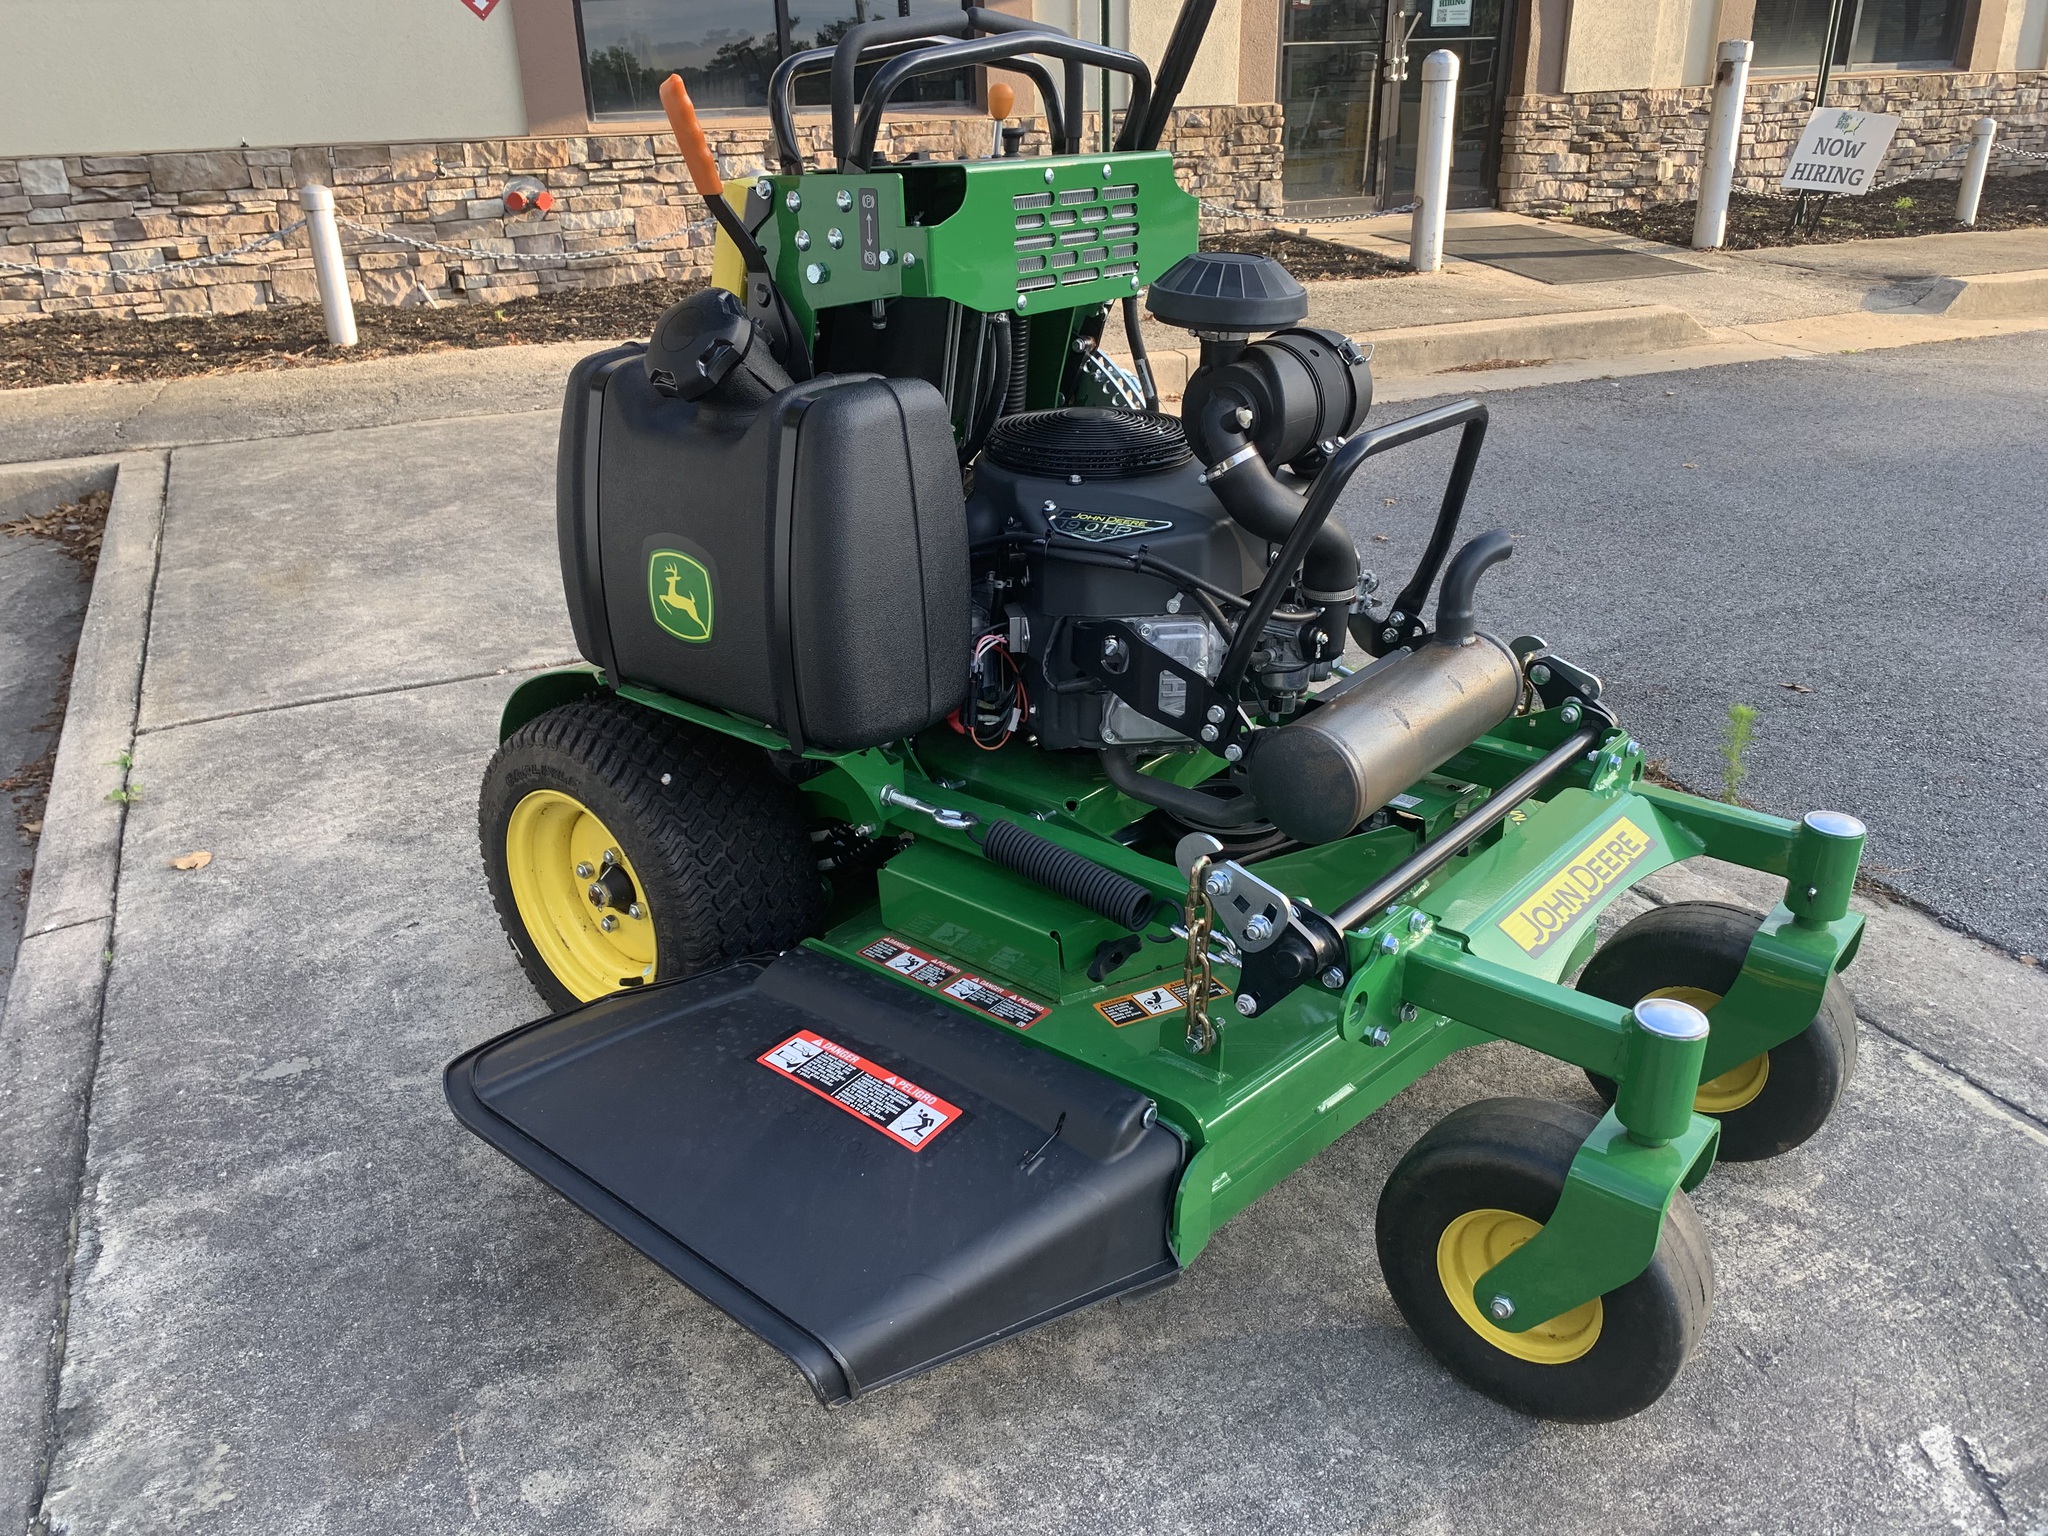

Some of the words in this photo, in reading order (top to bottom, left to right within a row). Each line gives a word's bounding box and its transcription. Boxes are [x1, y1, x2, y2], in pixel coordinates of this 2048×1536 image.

[1812, 137, 1867, 159] NOW
[1790, 163, 1865, 186] HIRING
[1071, 513, 1106, 524] JOHN
[1105, 516, 1148, 528] DEERE
[1519, 881, 1584, 942] JOHN
[1567, 830, 1642, 893] DEERE
[979, 979, 1005, 993] DANGER
[1017, 997, 1044, 1011] PELIGRO
[822, 1042, 860, 1064] DANGER
[895, 1080, 938, 1106] PELIGRO
